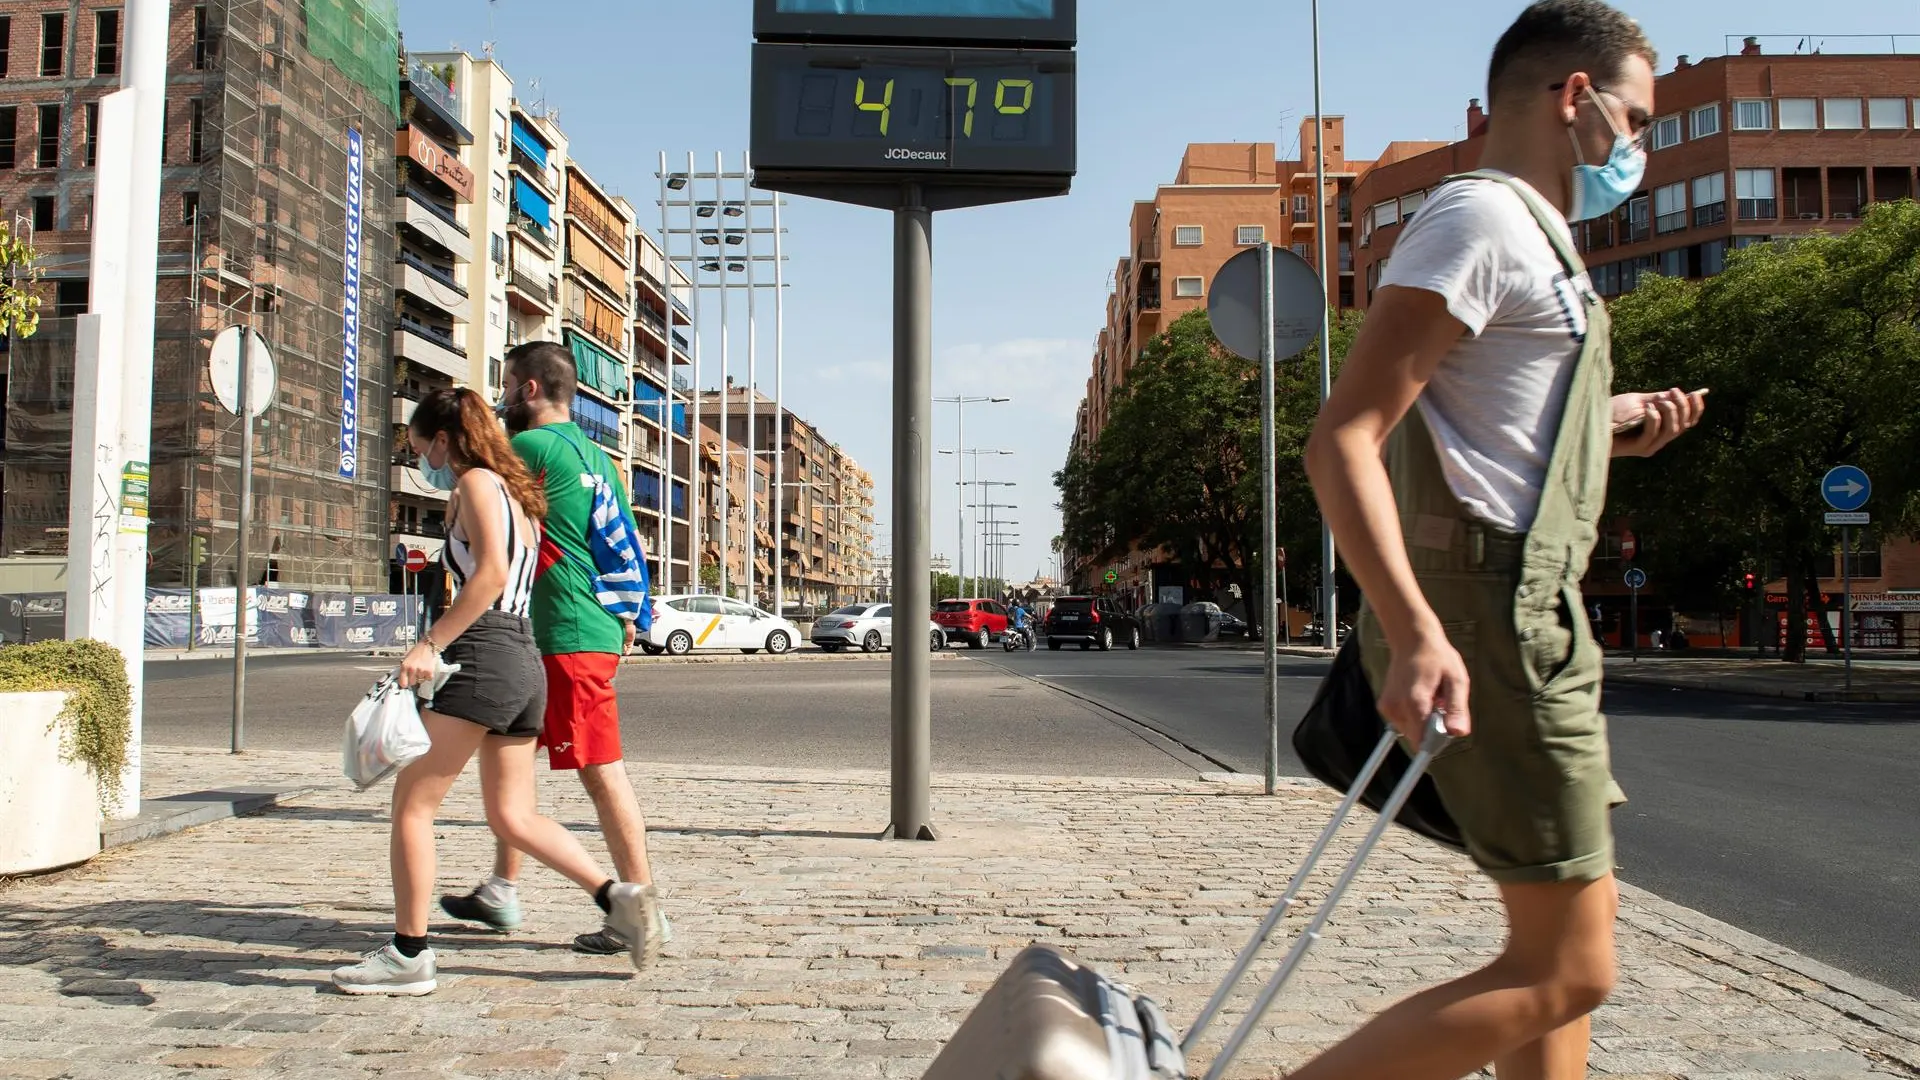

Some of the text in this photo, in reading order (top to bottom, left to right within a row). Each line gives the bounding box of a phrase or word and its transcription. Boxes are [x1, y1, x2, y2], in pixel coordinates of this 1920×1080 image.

[884, 148, 946, 160] JCDecaux
[344, 138, 360, 450] ACP INFRAESTRUCTURAS
[23, 598, 64, 612] ACP
[146, 595, 191, 609] ACP
[266, 595, 288, 609] ACP
[327, 600, 346, 612] ACP
[217, 625, 258, 640] AP
